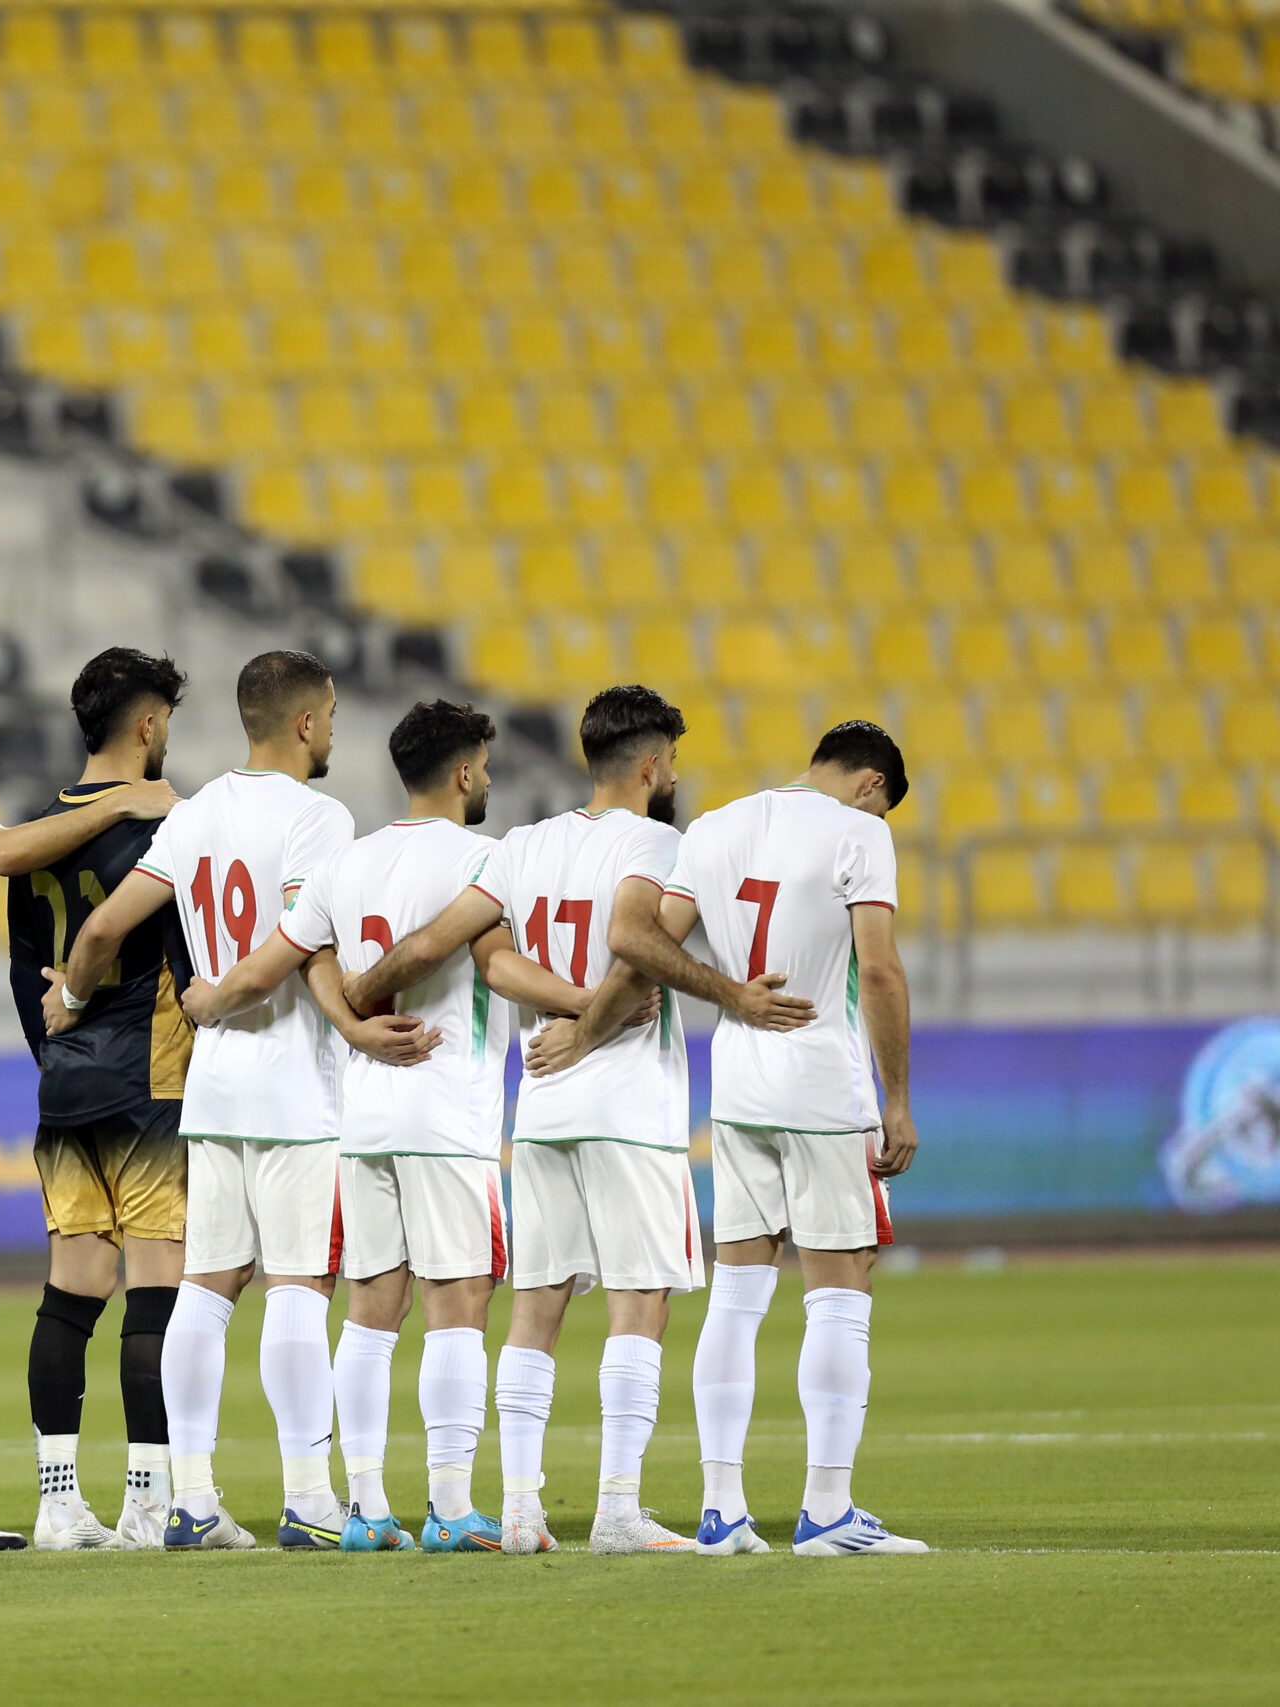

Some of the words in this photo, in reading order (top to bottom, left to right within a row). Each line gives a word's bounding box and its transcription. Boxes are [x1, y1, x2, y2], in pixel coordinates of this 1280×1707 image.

[191, 856, 257, 977] 19
[525, 896, 593, 1017] 17
[736, 877, 780, 982] 7
